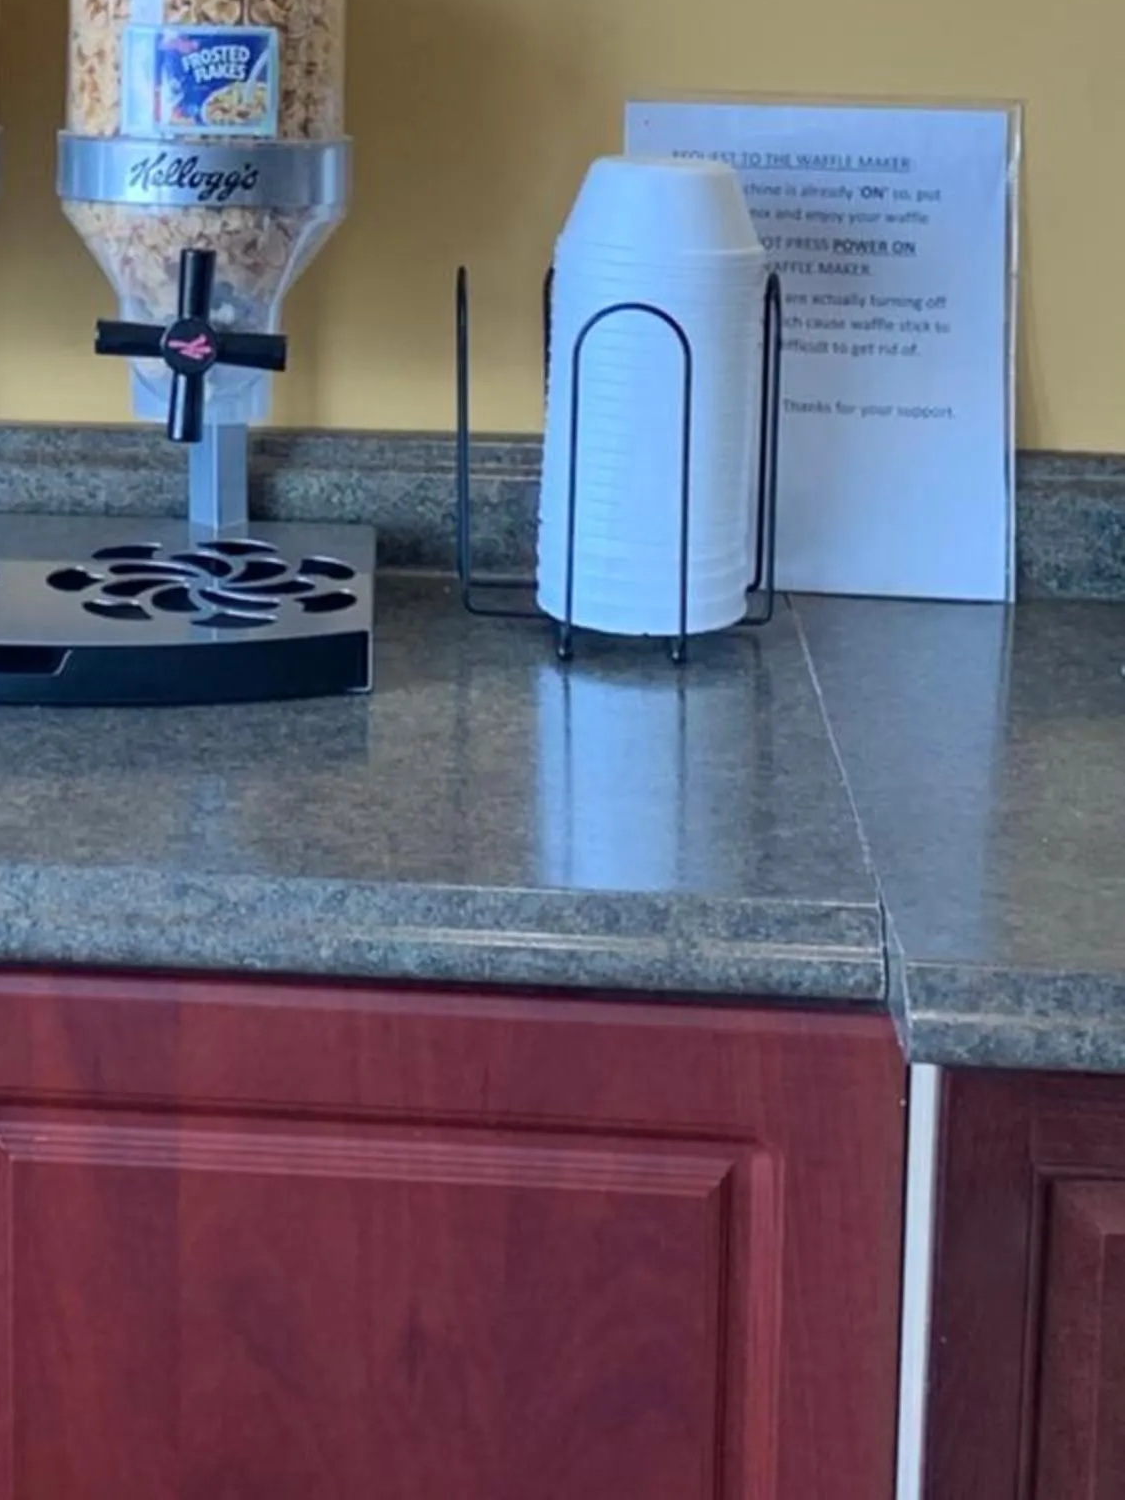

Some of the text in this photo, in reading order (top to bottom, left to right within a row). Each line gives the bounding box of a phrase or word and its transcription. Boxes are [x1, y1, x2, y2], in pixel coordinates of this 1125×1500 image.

[180, 43, 251, 73] FROSTED
[194, 63, 247, 84] FLAKES
[741, 152, 762, 168] TO
[766, 153, 792, 169] THE
[796, 154, 851, 169] WAFFLE
[129, 152, 261, 202] Kellogg's
[800, 184, 854, 201] already
[916, 187, 941, 203] put
[775, 207, 802, 221] and
[805, 209, 843, 225] enjoy
[848, 211, 881, 226] your
[760, 235, 916, 255] OT PRESS POWER ON
[812, 292, 865, 309] actually
[869, 294, 922, 311] turning
[925, 296, 947, 310] off
[805, 318, 845, 330] cause
[850, 316, 895, 332] waffle
[899, 318, 930, 334] stick
[935, 321, 952, 334] to
[832, 341, 849, 355] to
[851, 342, 875, 358] get
[878, 341, 898, 356] rid
[783, 398, 833, 415] Thanks
[835, 401, 856, 415] for
[860, 405, 893, 419] your
